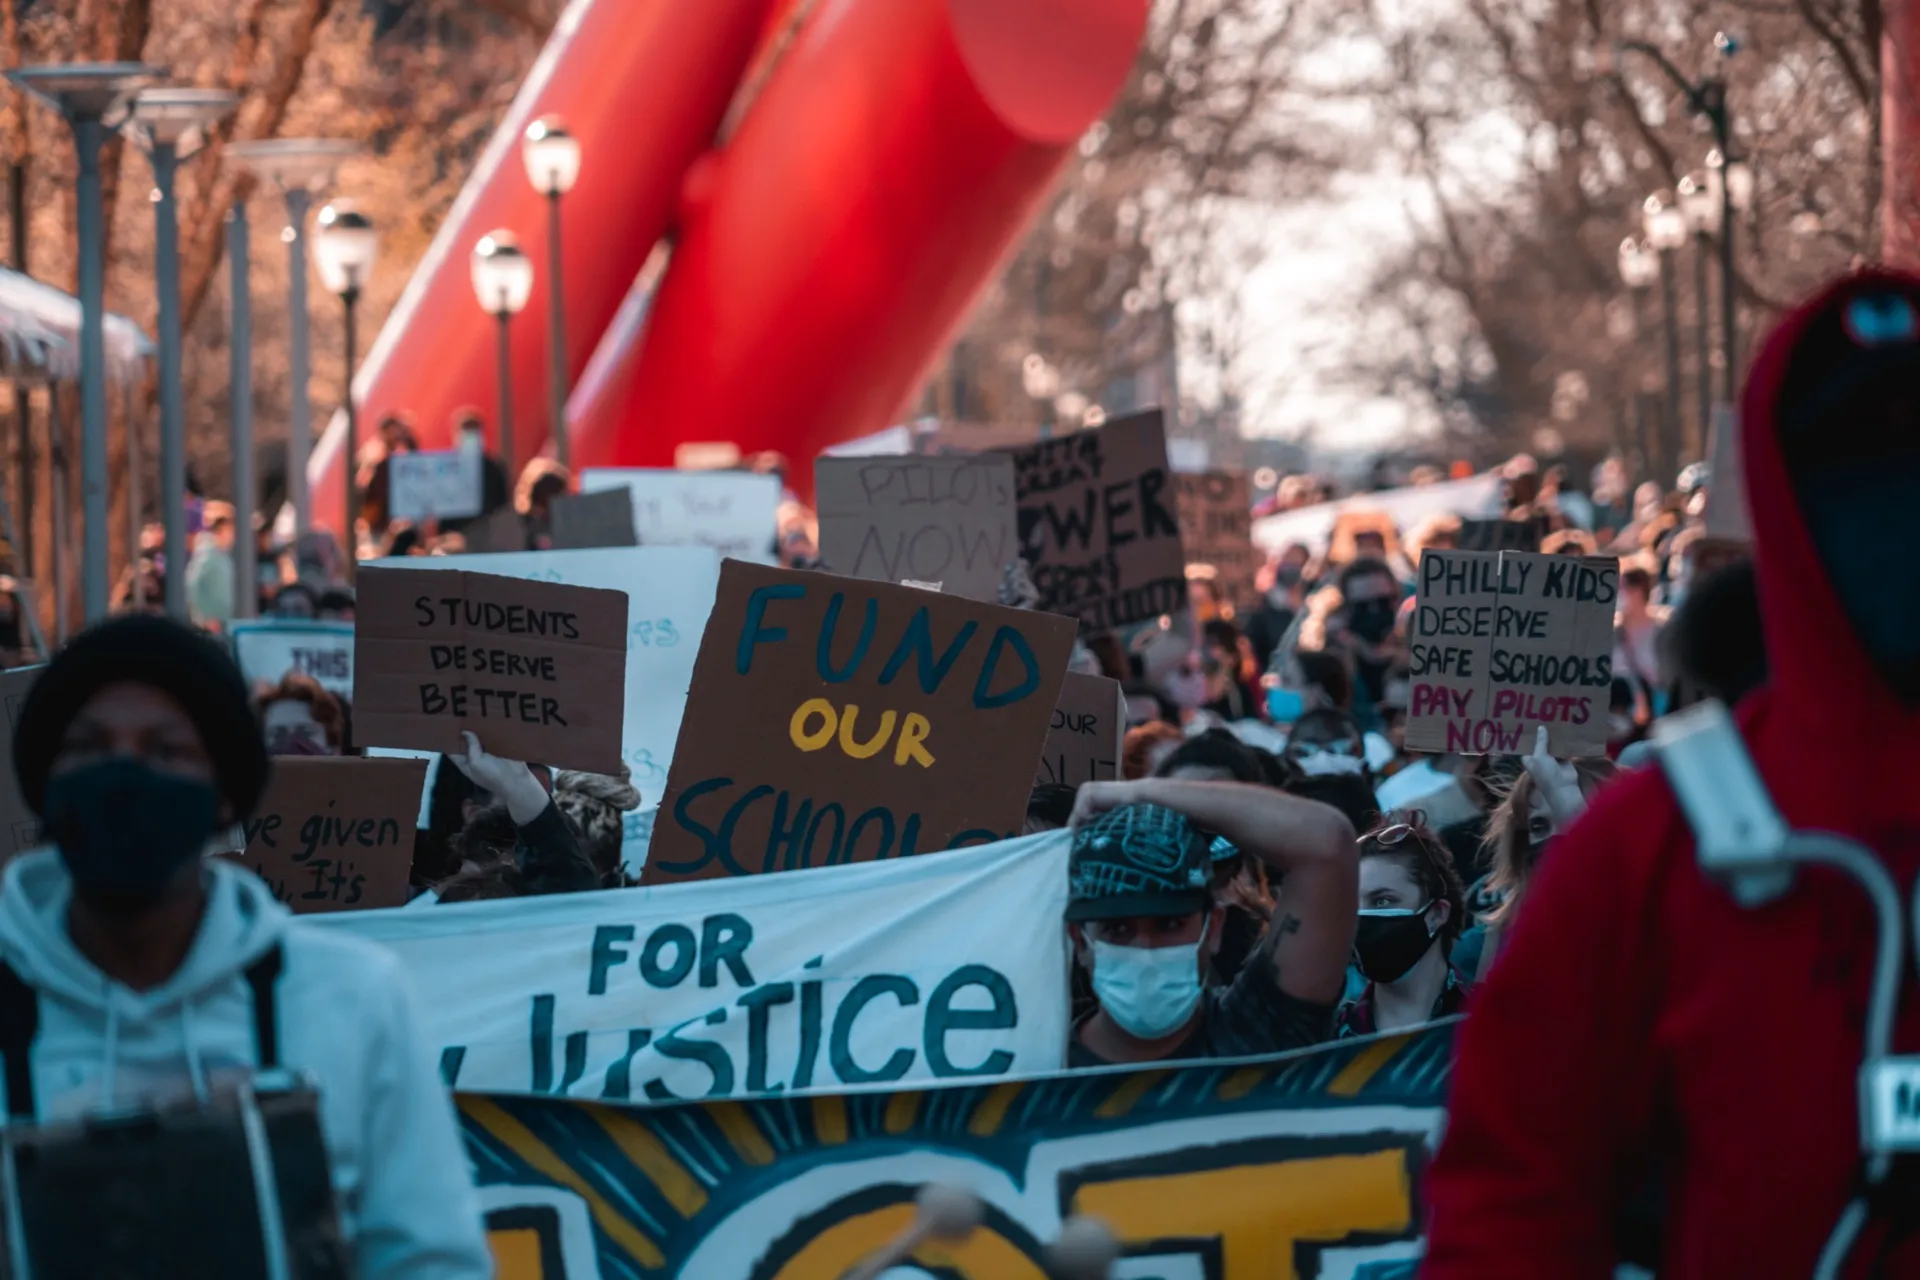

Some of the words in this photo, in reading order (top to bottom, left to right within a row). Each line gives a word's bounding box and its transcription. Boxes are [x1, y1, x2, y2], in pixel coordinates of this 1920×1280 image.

[852, 523, 1007, 581] NOW
[1423, 554, 1533, 598] PHILLY
[1542, 561, 1616, 604] KIDS
[414, 596, 579, 639] STUDENTS
[1419, 605, 1549, 638] DESERVE
[290, 647, 349, 679] THIS
[430, 645, 556, 681] DESERVE
[736, 583, 1042, 709] FUND
[1410, 645, 1473, 677] SAFE
[1489, 649, 1612, 687] SCHOOLS
[419, 683, 568, 727] BETTER
[1411, 683, 1473, 718] PAY
[1492, 689, 1592, 724] PILOTS
[789, 697, 935, 768] OUR
[1446, 718, 1524, 753] NOW
[243, 813, 282, 847] ve
[291, 799, 399, 862] given
[655, 777, 1016, 875] SCHOOL
[301, 858, 366, 904] It's
[589, 912, 755, 994] FOR
